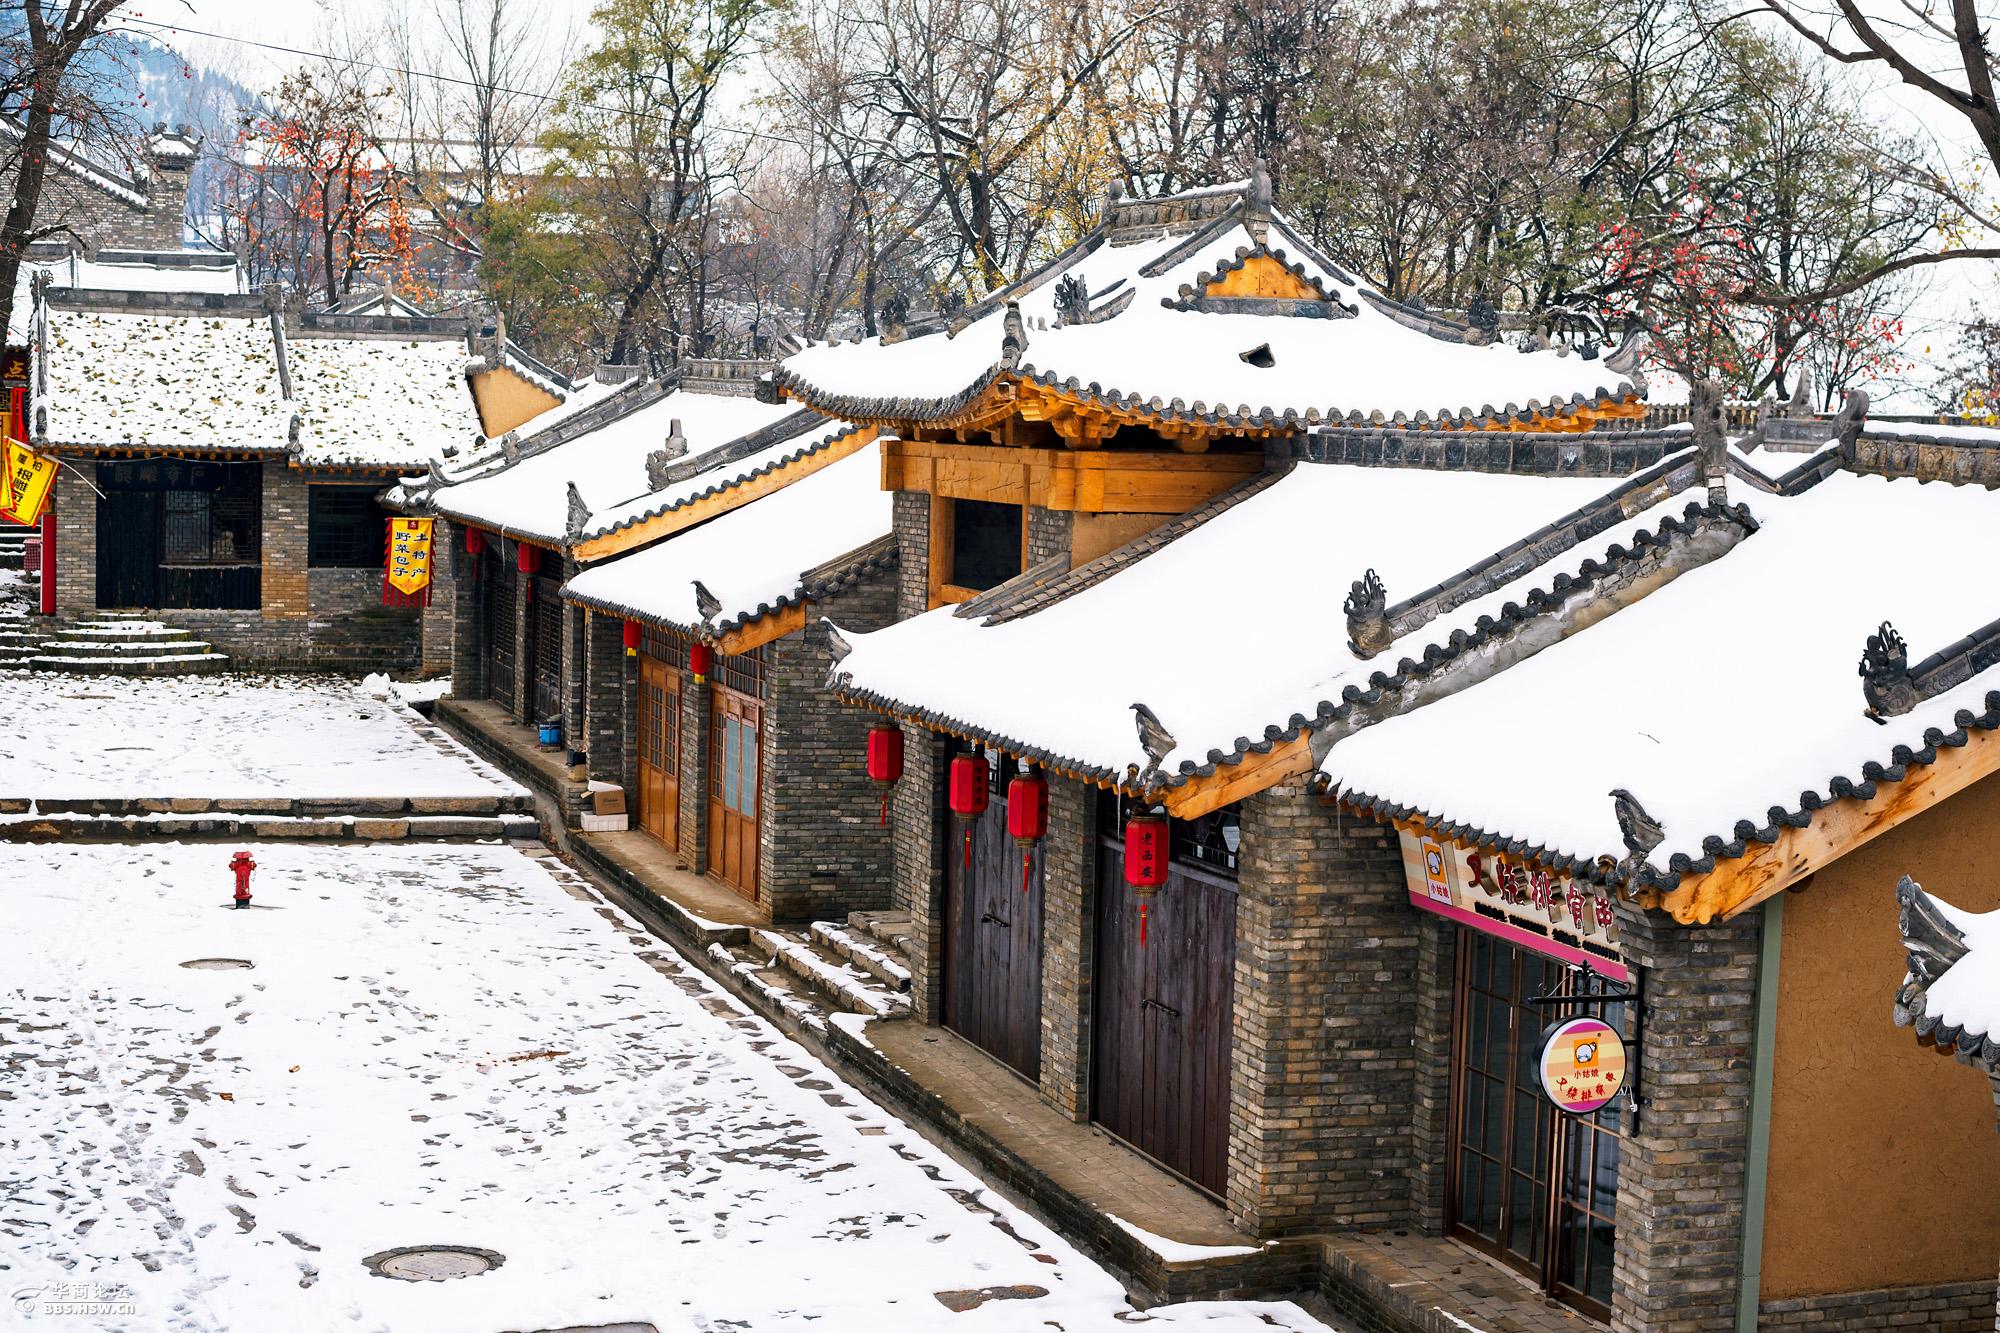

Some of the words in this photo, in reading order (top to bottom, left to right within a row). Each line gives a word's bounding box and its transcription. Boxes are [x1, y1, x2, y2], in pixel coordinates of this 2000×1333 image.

[4, 360, 27, 379] 点
[393, 531, 411, 577] 野菜包子
[411, 533, 428, 577] 土特产
[1142, 832, 1153, 878] 老西安
[1431, 883, 1449, 899] 小姑娘
[1574, 1068, 1599, 1080] 小姑娘
